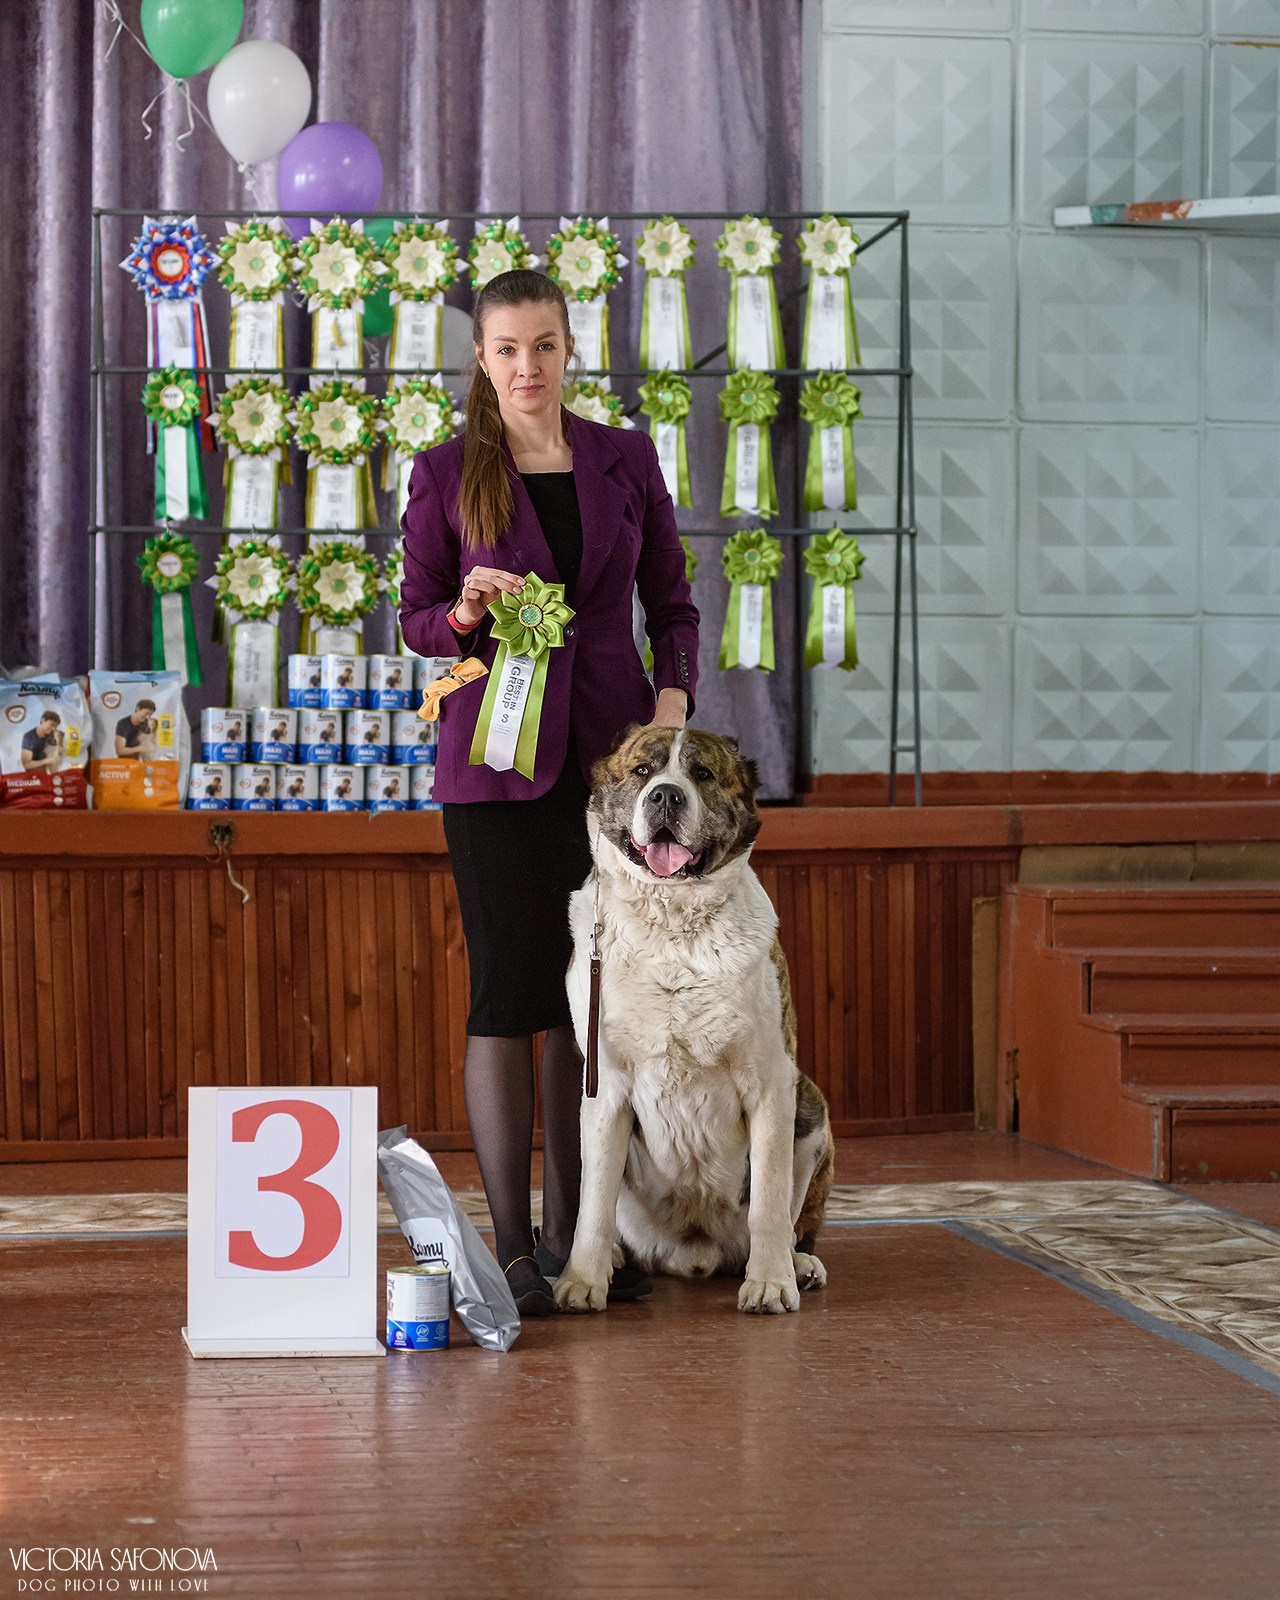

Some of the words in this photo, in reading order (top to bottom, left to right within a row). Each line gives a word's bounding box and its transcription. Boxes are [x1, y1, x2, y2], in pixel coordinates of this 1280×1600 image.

[502, 666, 521, 709] GROUP
[513, 678, 524, 700] BEST
[509, 701, 517, 711] IN
[7, 778, 41, 787] MEDIUM
[98, 771, 131, 779] ACTIVE
[228, 1099, 343, 1272] 3
